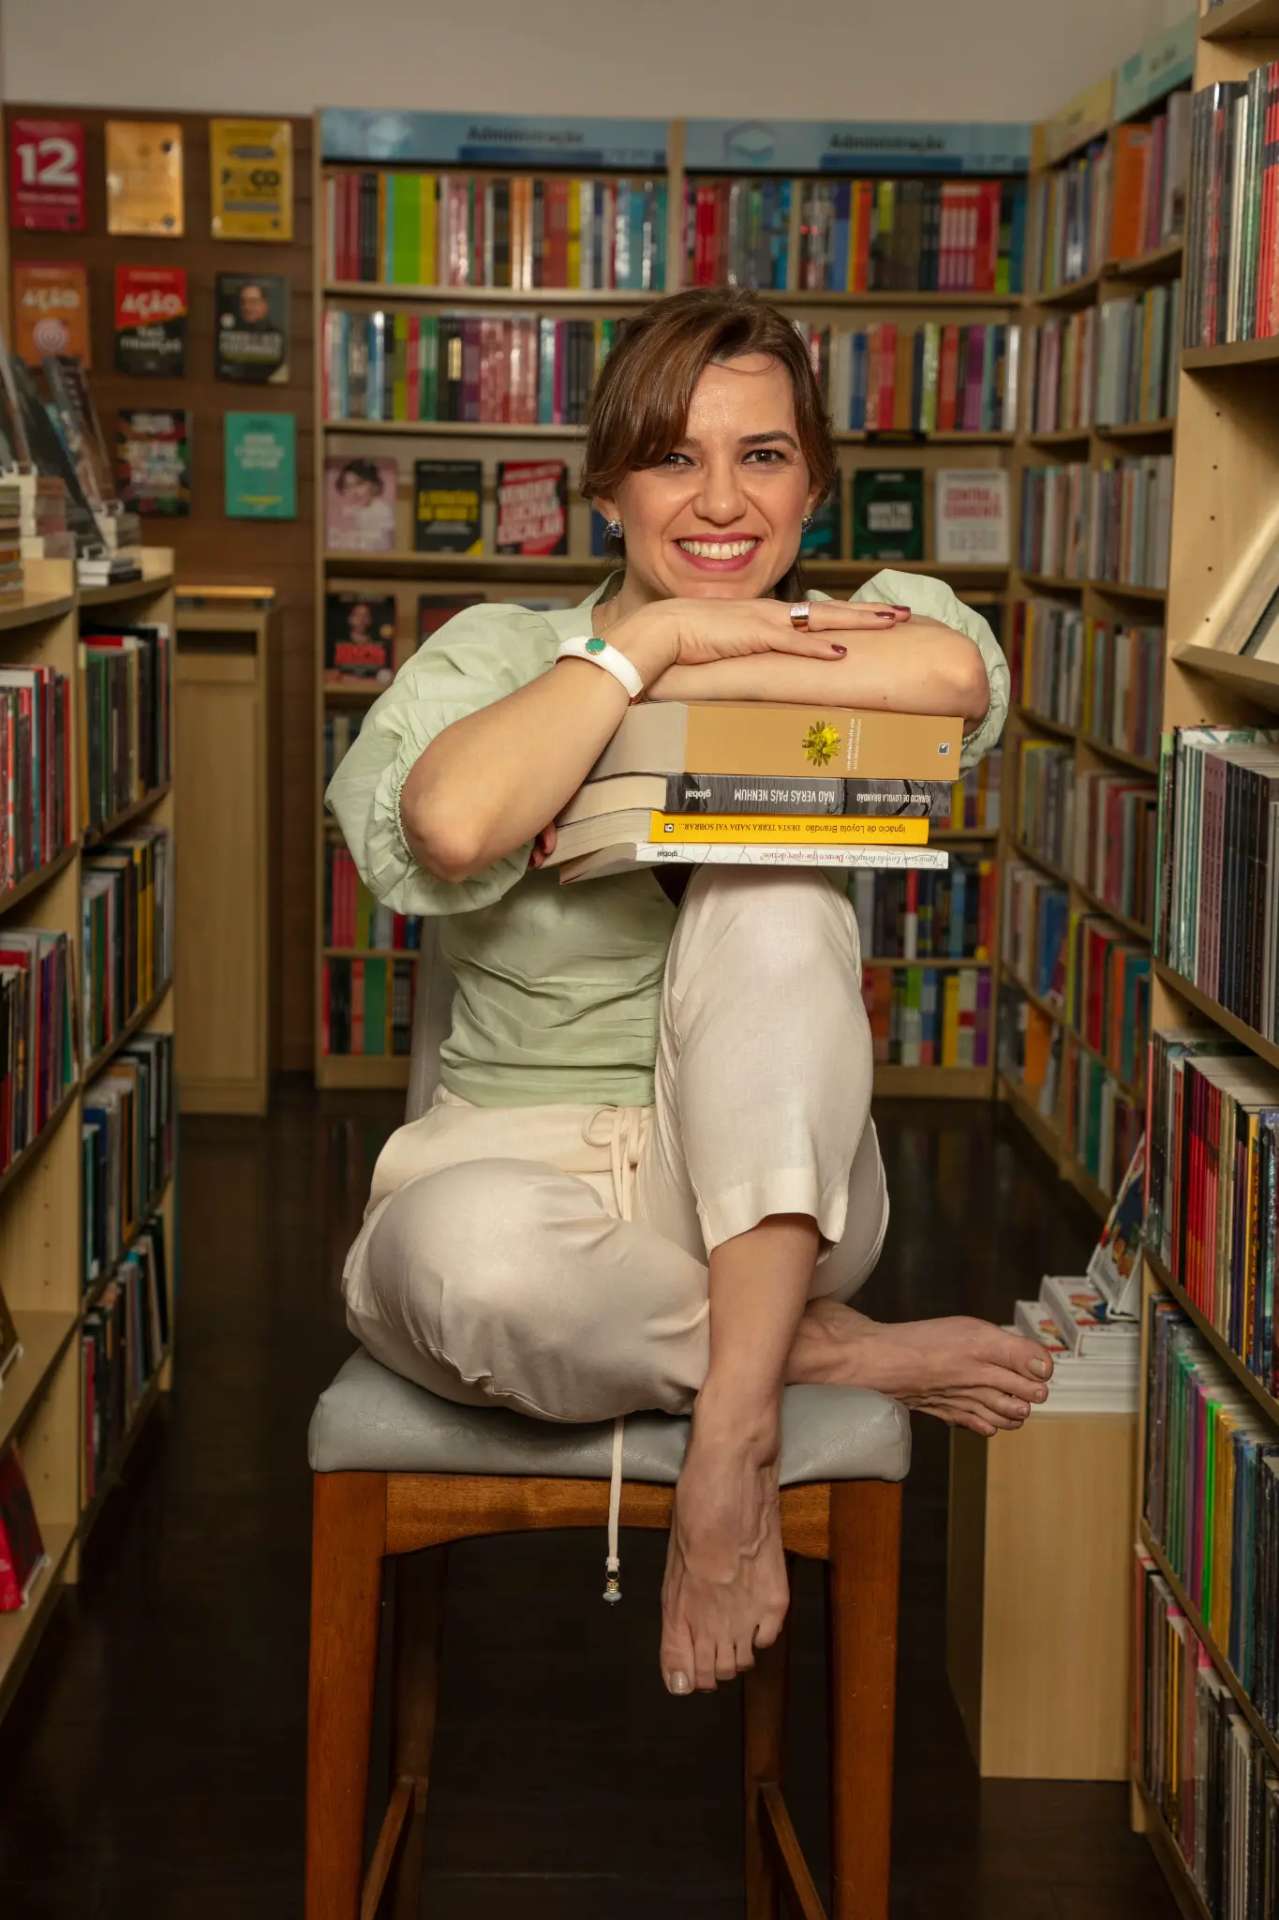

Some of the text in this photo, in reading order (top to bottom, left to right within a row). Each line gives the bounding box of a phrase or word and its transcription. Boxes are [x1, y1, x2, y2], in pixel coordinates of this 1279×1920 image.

[16, 136, 80, 188] 12
[685, 788, 712, 800] global
[734, 788, 835, 805] NÃO VERÁS PAÍS NENHUM
[715, 823, 728, 831] VAI
[730, 823, 752, 832] NADA
[753, 823, 777, 832] TERRA
[778, 824, 800, 833] DESTA
[805, 823, 837, 834] Brandão
[840, 823, 864, 834] Loyola
[867, 824, 877, 833] de
[656, 850, 678, 859] global
